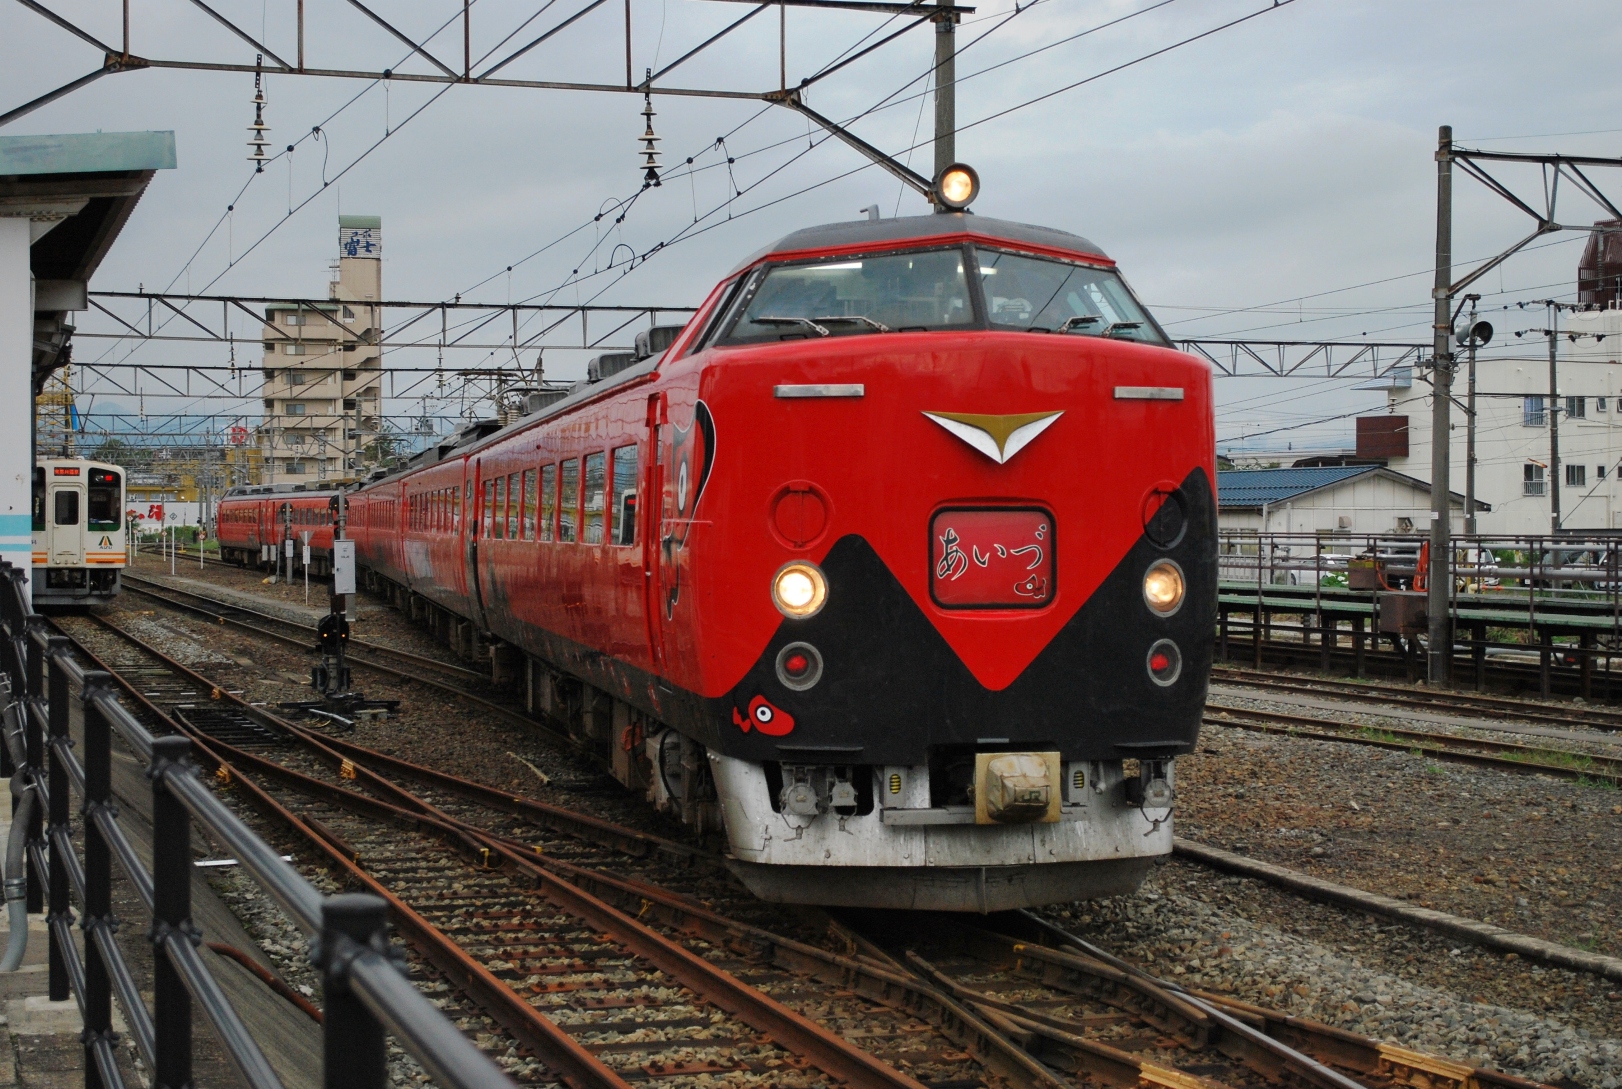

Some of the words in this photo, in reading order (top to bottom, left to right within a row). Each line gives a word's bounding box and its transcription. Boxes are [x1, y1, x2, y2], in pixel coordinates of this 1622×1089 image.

[937, 524, 1046, 581] あいづ
[1021, 790, 1041, 803] JR
